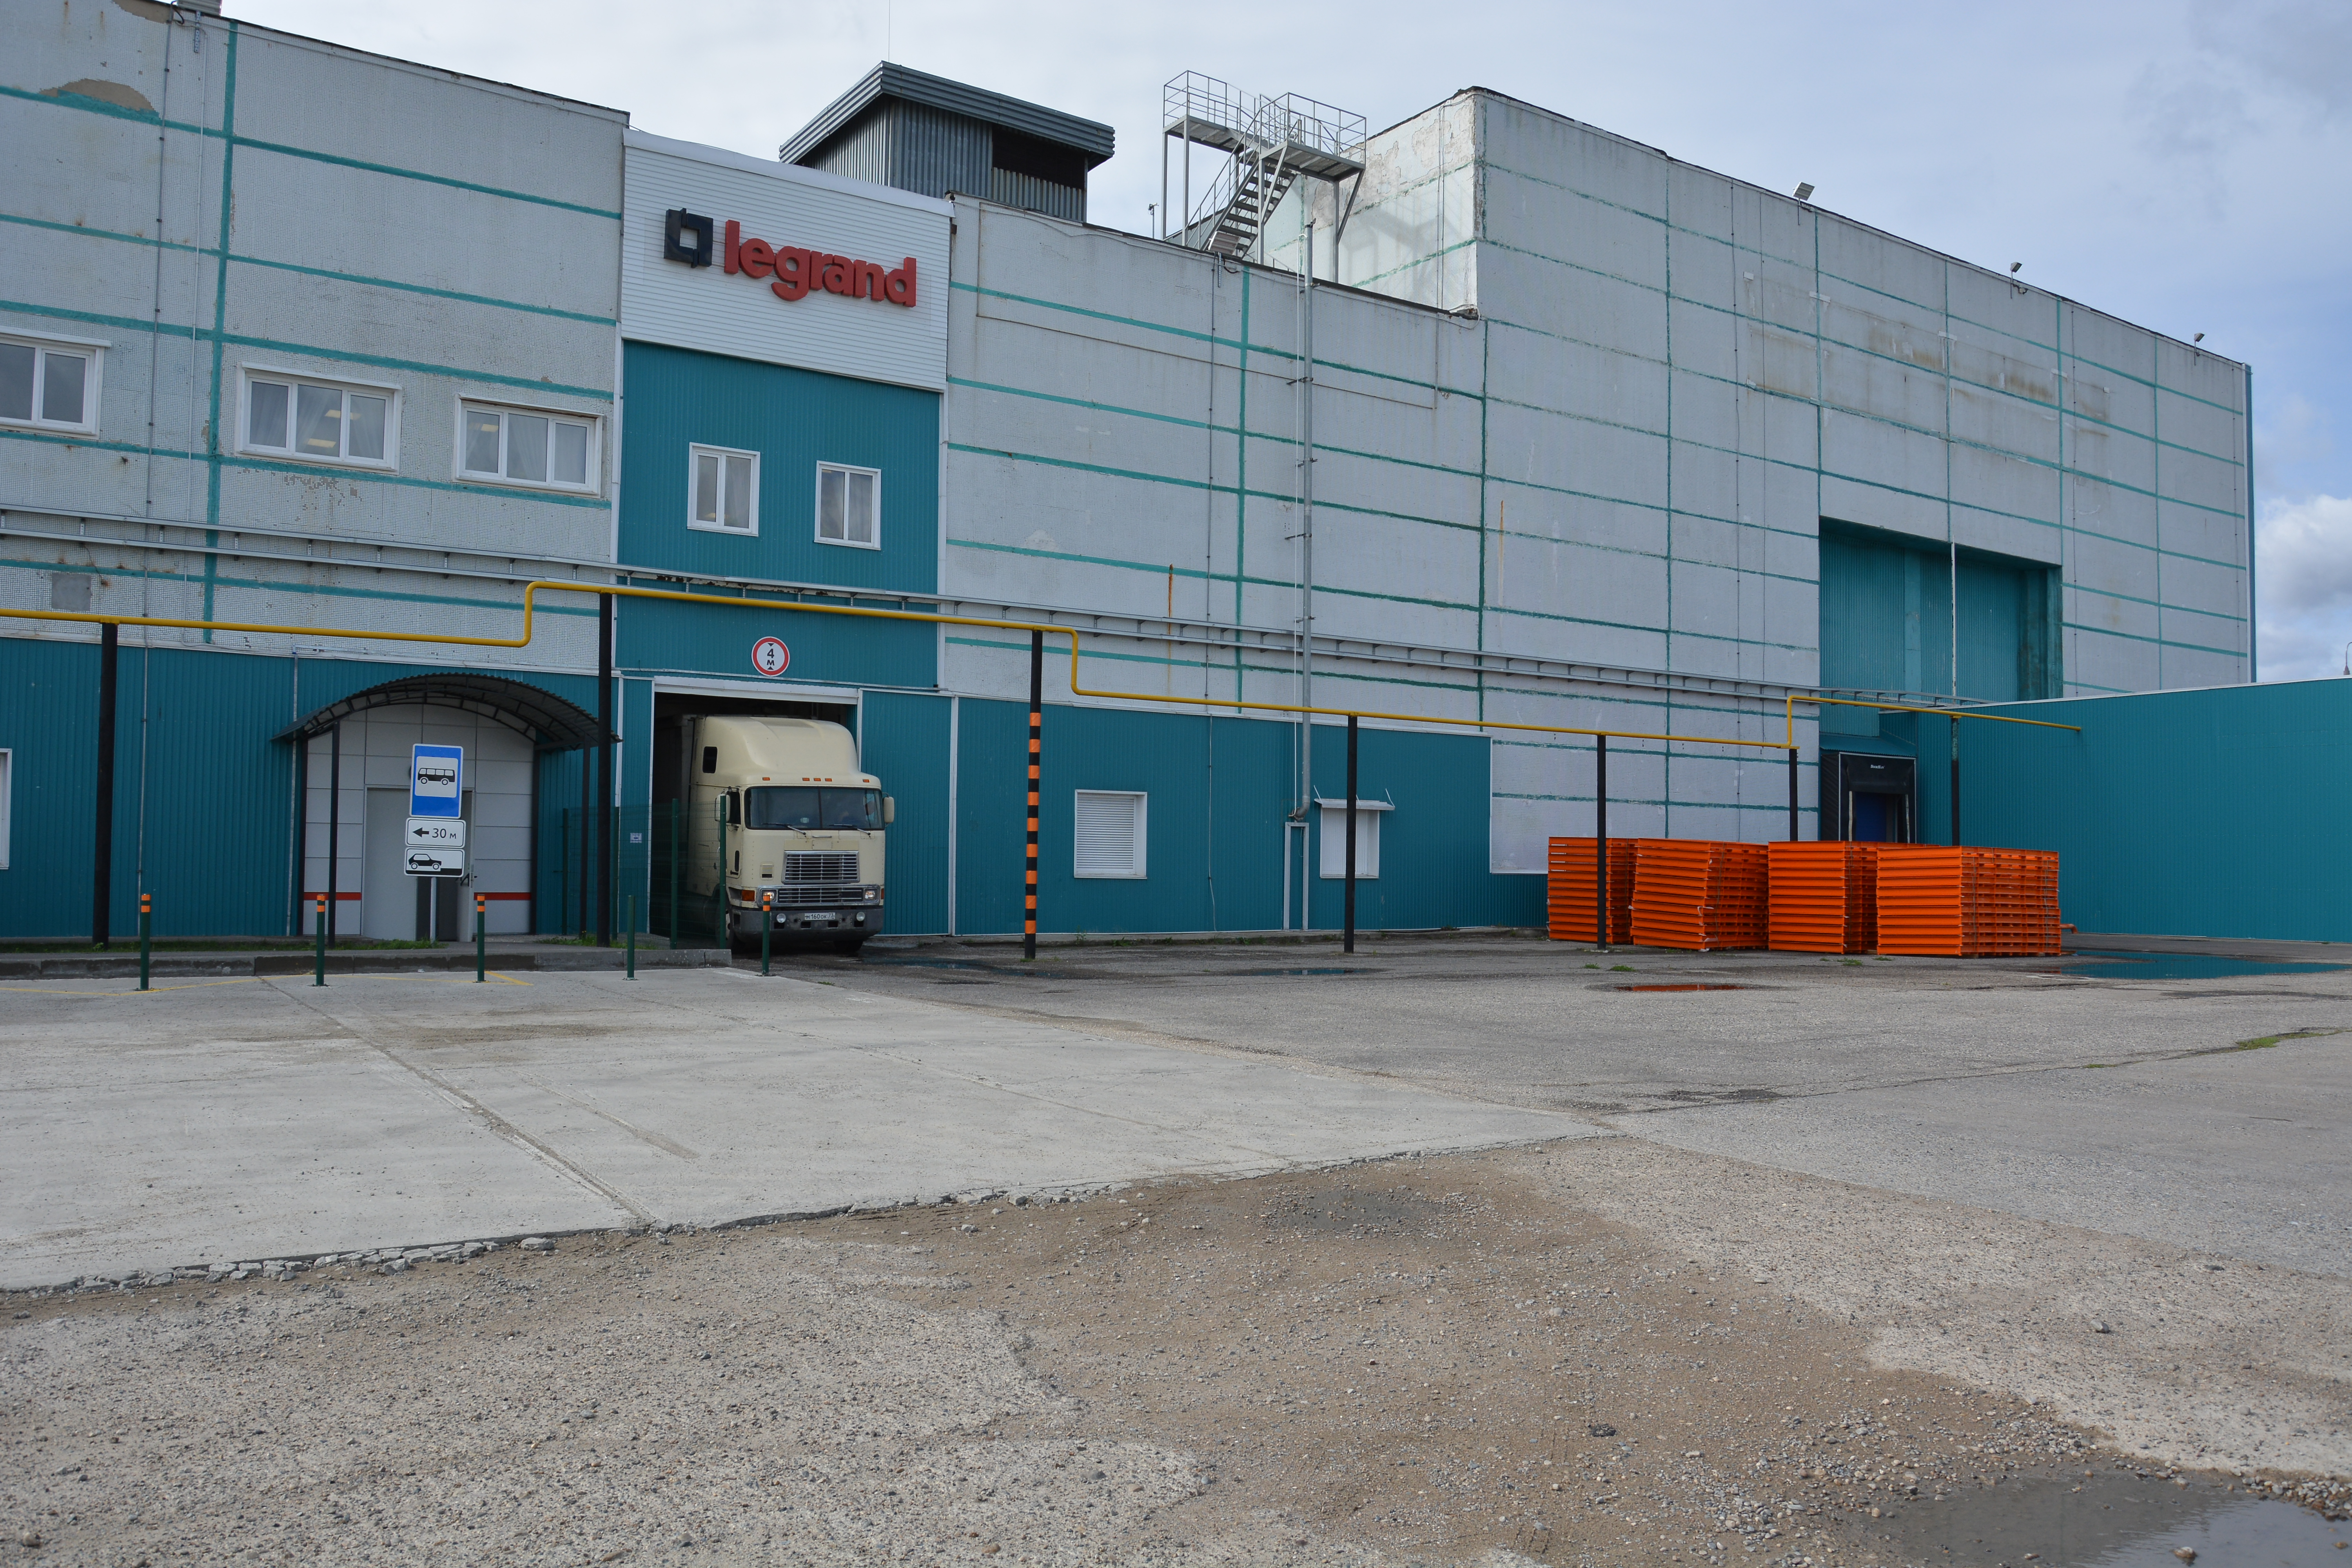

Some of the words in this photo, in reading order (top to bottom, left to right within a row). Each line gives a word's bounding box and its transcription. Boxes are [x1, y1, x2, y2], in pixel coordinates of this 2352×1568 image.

[724, 220, 916, 307] legrand
[767, 648, 774, 659] 4
[432, 828, 446, 838] 30
